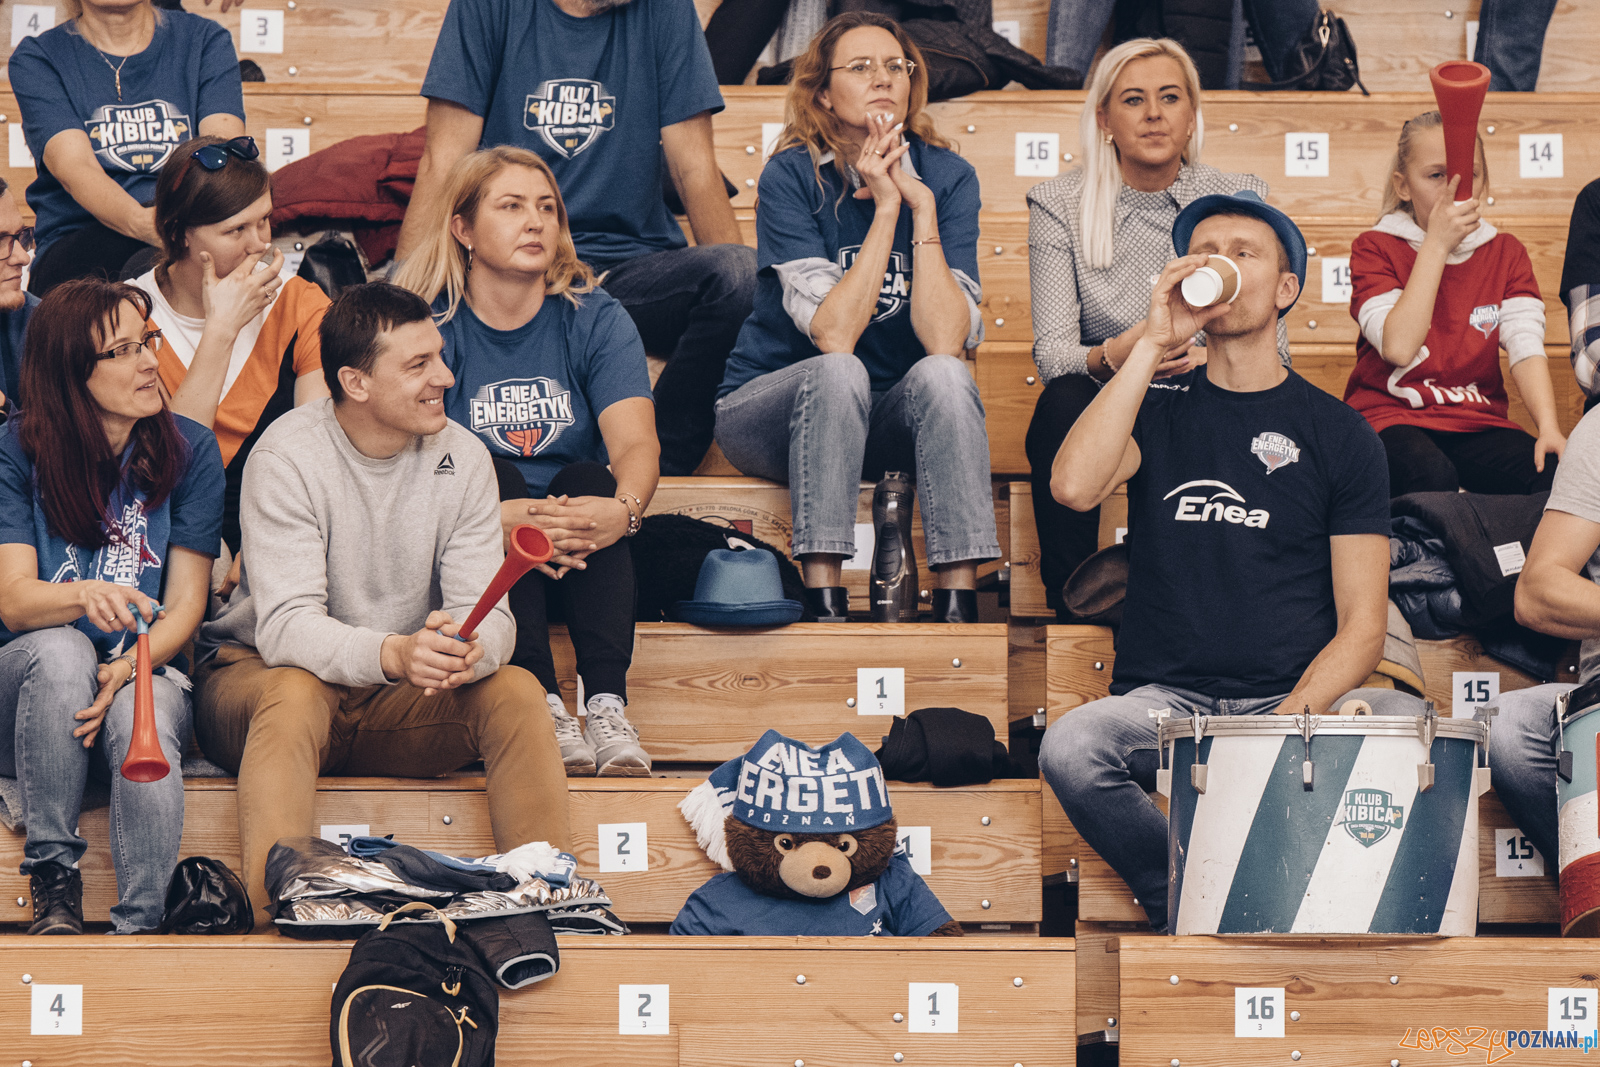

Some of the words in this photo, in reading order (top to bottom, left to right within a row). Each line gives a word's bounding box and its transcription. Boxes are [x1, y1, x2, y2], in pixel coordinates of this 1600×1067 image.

[27, 13, 40, 32] 4
[256, 17, 268, 37] 3
[116, 107, 157, 123] KLUB
[99, 119, 179, 148] KIBICA
[282, 136, 294, 156] 3
[1026, 141, 1049, 160] 16
[1296, 141, 1318, 160] 15
[1529, 142, 1553, 161] 14
[500, 383, 540, 403] ENEA
[473, 393, 573, 426] ENERGETYK
[1252, 439, 1299, 460] ENERGETYK
[1268, 435, 1287, 446] ENEA
[1174, 496, 1270, 529] Enea
[875, 676, 888, 699] 1
[1464, 680, 1490, 702] 15
[1355, 793, 1382, 806] KLUB
[747, 809, 855, 826] POZNAŃ
[617, 832, 630, 855] 2
[901, 835, 913, 858] 1
[1506, 836, 1534, 860] 15
[49, 993, 65, 1017] 4
[637, 993, 652, 1017] 2
[927, 991, 940, 1016] 1
[1247, 995, 1275, 1020] 16
[1559, 996, 1588, 1020] 15
